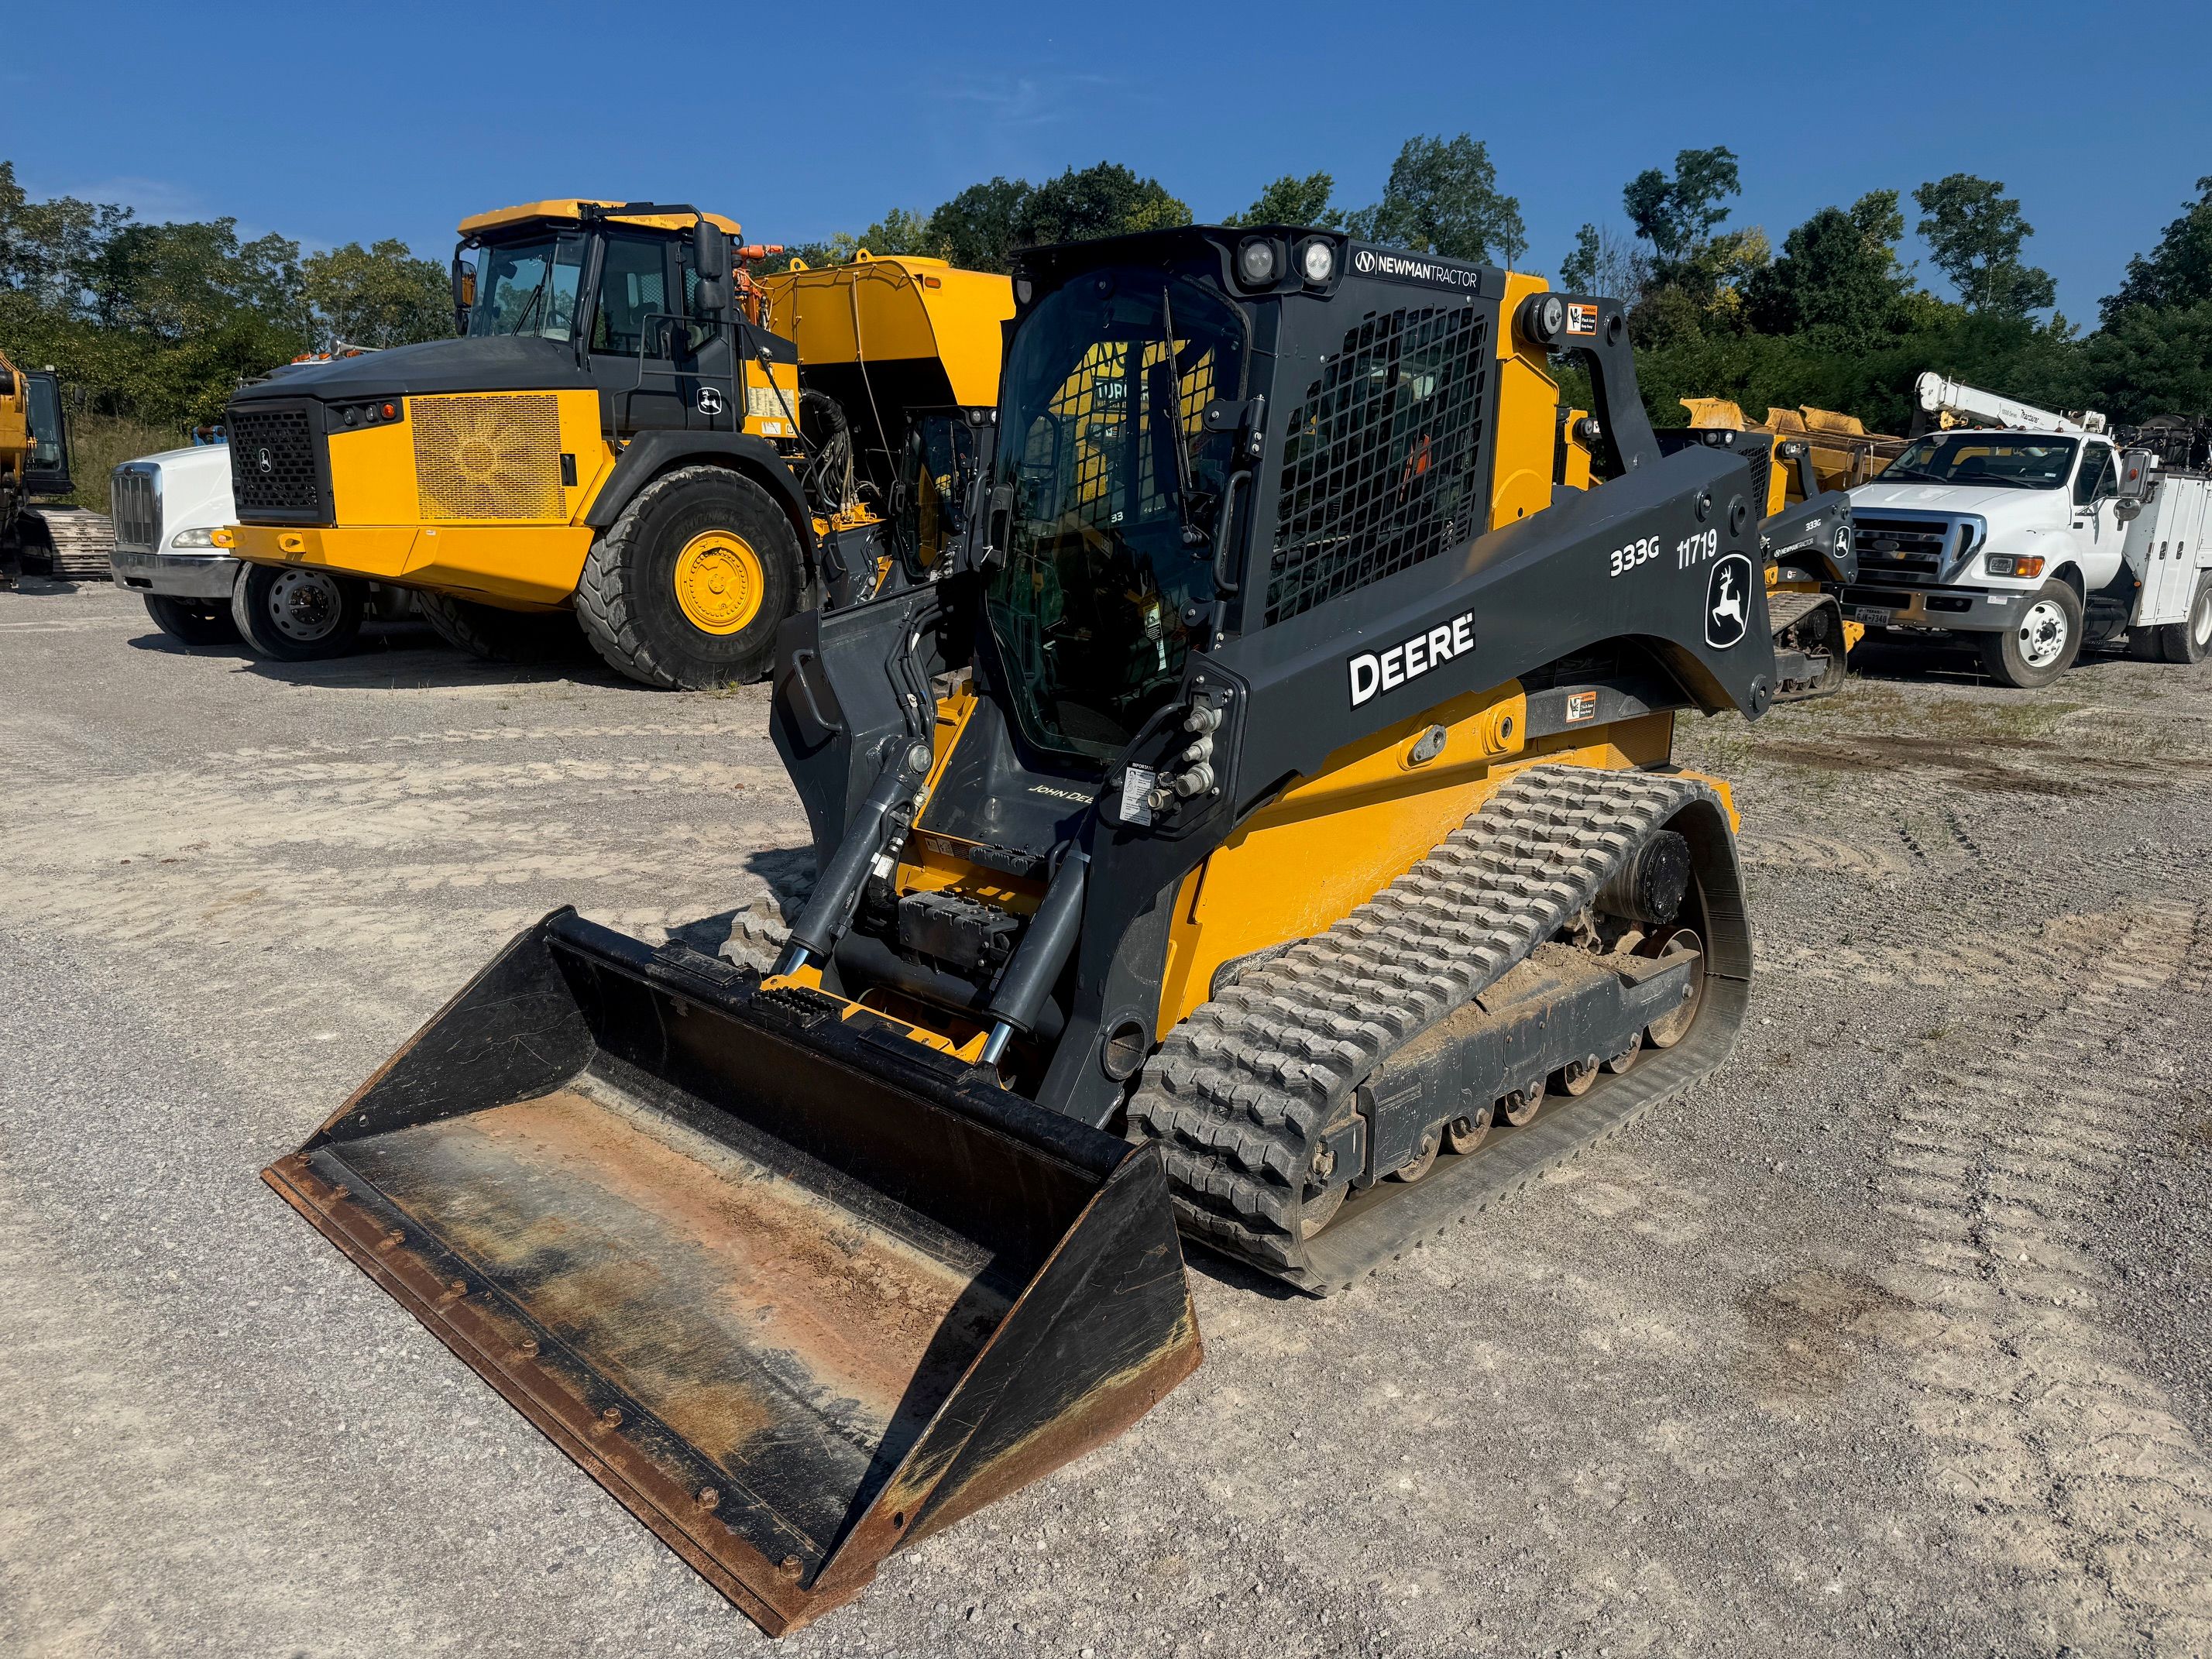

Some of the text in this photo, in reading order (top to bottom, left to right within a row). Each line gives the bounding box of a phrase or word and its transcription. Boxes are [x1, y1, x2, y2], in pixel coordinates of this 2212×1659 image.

[1378, 256, 1477, 288] NEWMANTRACTOR
[1805, 518, 1822, 532] 333G
[1610, 528, 1718, 577] 333G 11719
[1349, 612, 1474, 706] DEERE
[1028, 785, 1094, 804] JOHN DEE
